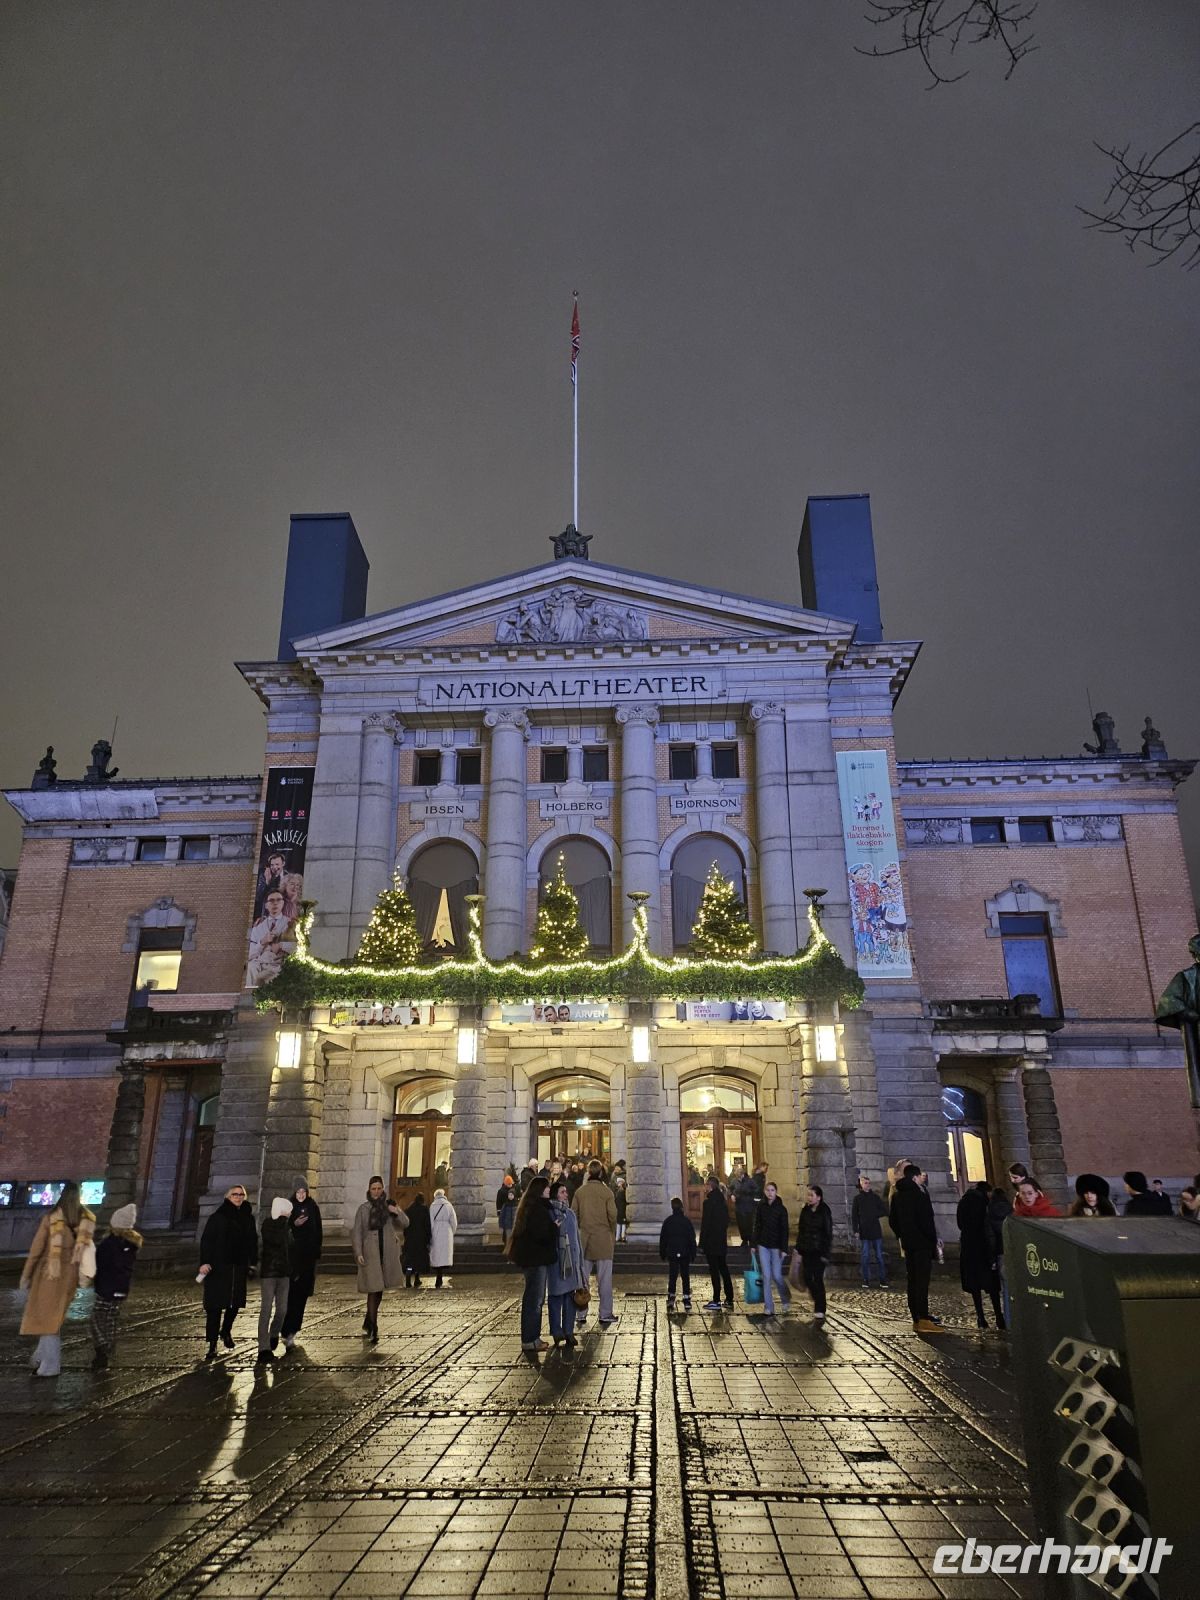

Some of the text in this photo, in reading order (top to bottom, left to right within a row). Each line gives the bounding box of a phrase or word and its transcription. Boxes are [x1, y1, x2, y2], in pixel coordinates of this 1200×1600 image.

[435, 676, 708, 700] NATIONALTHEATER
[425, 805, 464, 815] IBSEN
[546, 802, 603, 811] HOLBERG
[264, 829, 308, 847] KARUSELL
[575, 1010, 605, 1019] ARVEN
[1042, 1258, 1059, 1272] Oslo
